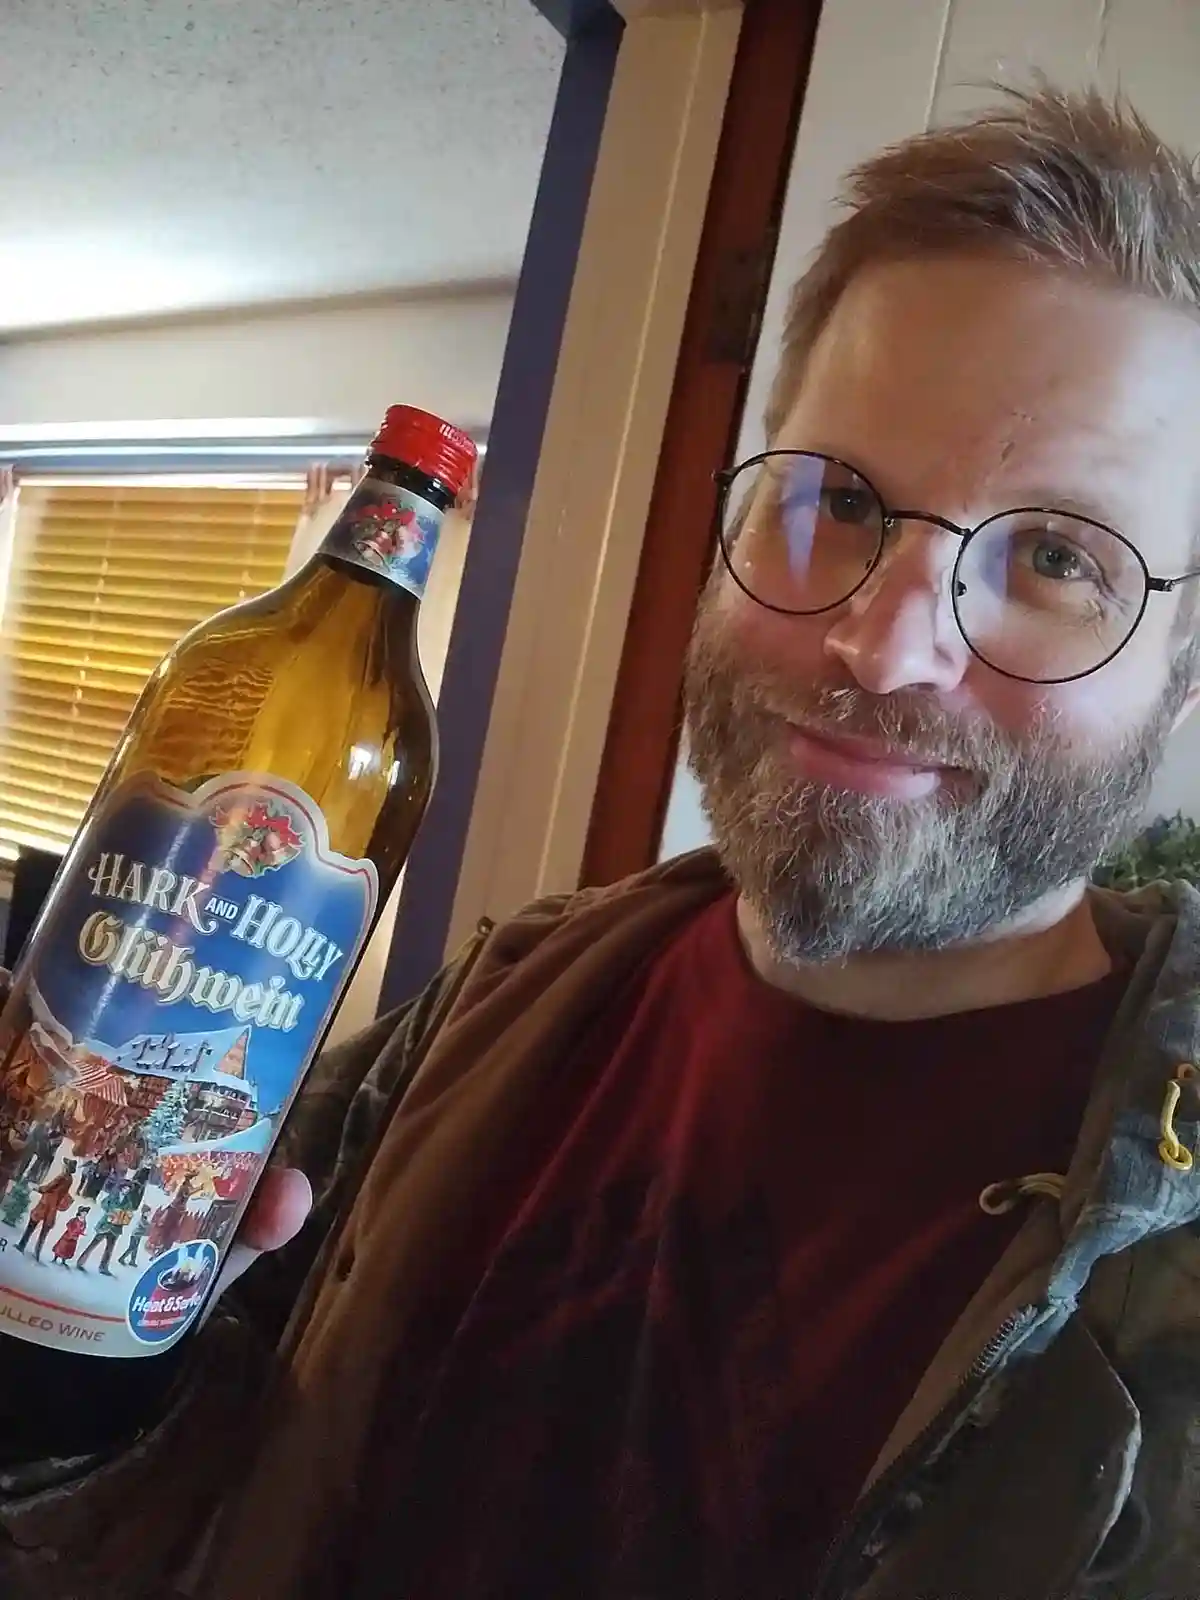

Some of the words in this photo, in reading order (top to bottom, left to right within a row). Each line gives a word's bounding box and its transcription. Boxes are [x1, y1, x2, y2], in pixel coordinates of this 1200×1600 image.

[78, 911, 306, 1033] Glühwein
[88, 851, 217, 935] HARK
[204, 894, 239, 921] AND
[231, 894, 344, 982] HOLLY
[59, 1322, 105, 1342] WINE
